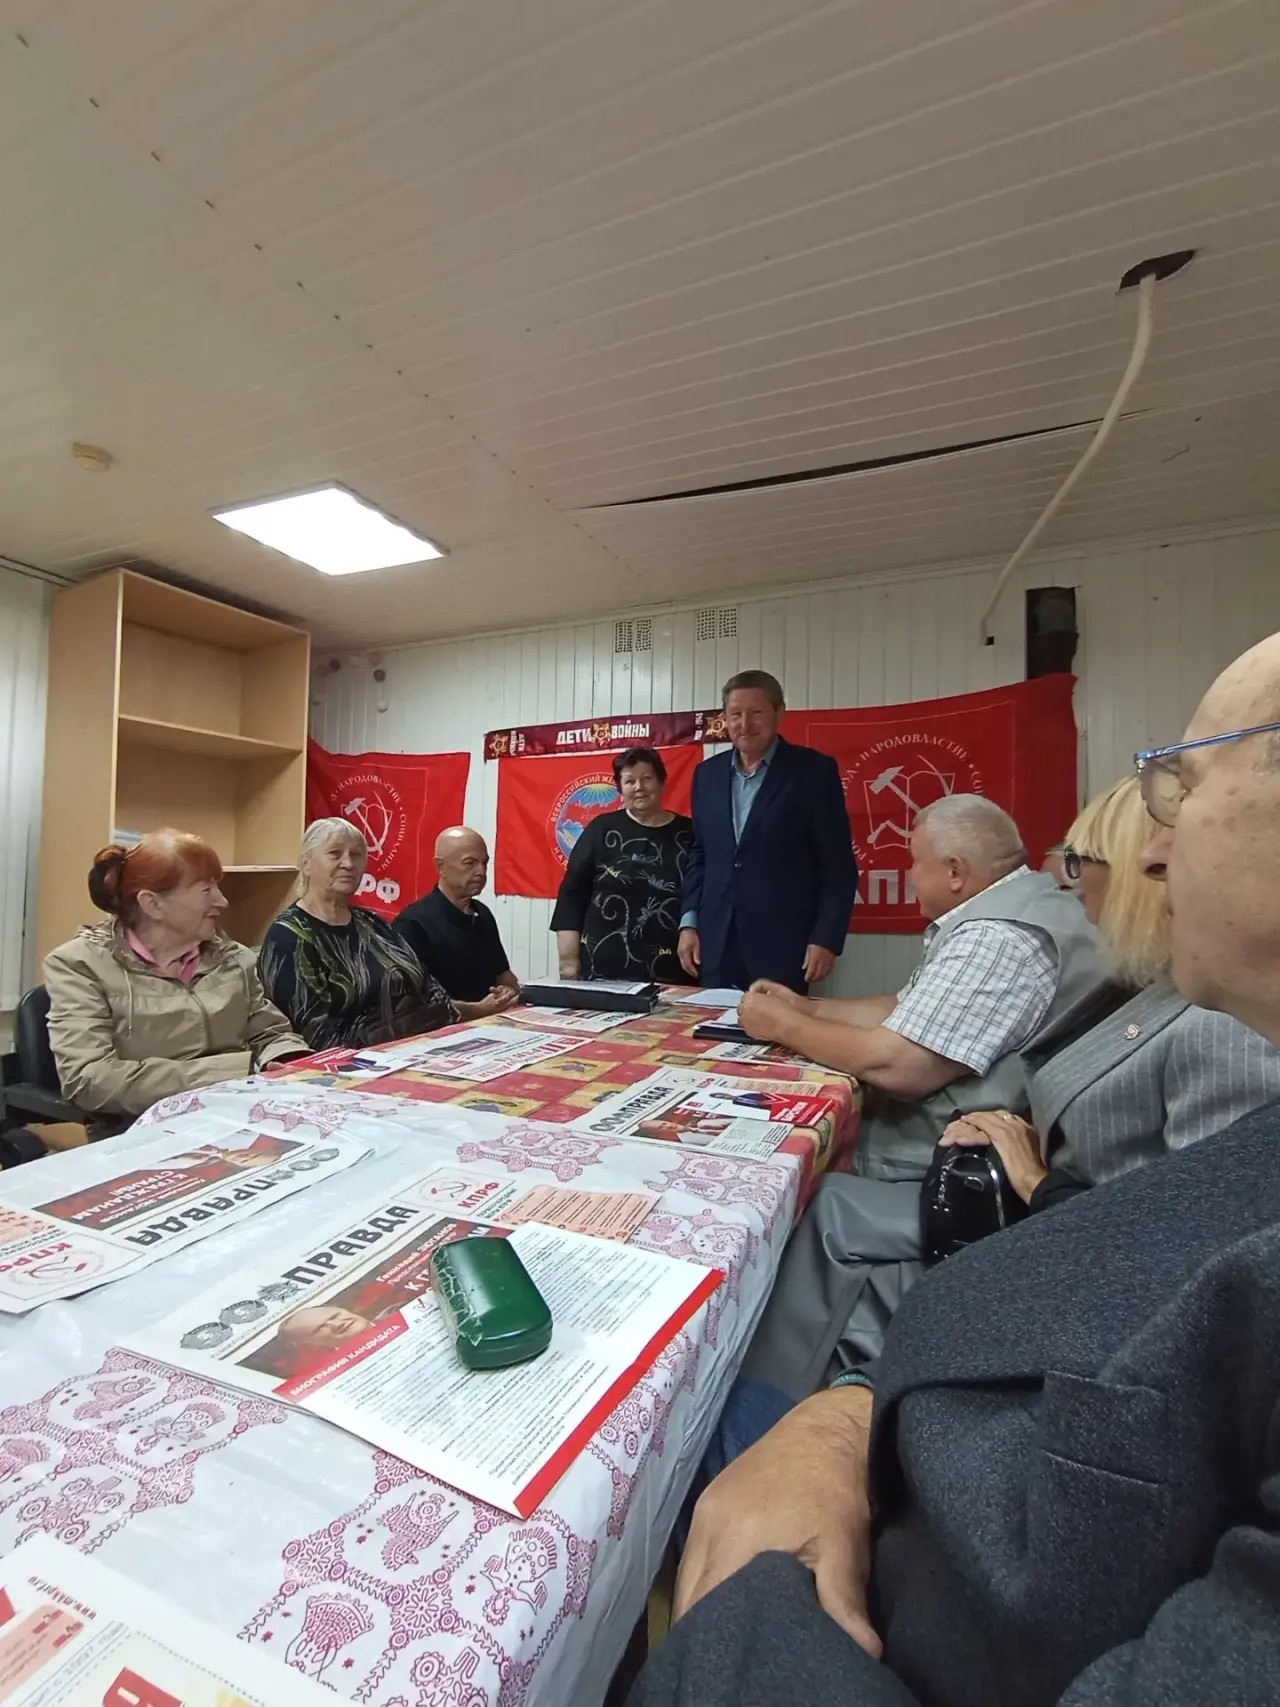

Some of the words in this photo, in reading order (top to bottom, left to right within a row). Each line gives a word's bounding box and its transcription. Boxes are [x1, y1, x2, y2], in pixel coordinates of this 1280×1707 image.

[556, 727, 592, 745] ДЕТИ
[611, 720, 650, 740] ВОЙНЫ
[859, 733, 969, 762] НАРОДОВЛАСТИЕ
[353, 873, 401, 904] РФ
[124, 1174, 279, 1246] ПРАВДА
[457, 1181, 500, 1208] КПРФ
[281, 1204, 420, 1286] ПРАВДА
[289, 1357, 350, 1396] БИОГРАФИЯ
[347, 1324, 401, 1359] КАНДИДАТА
